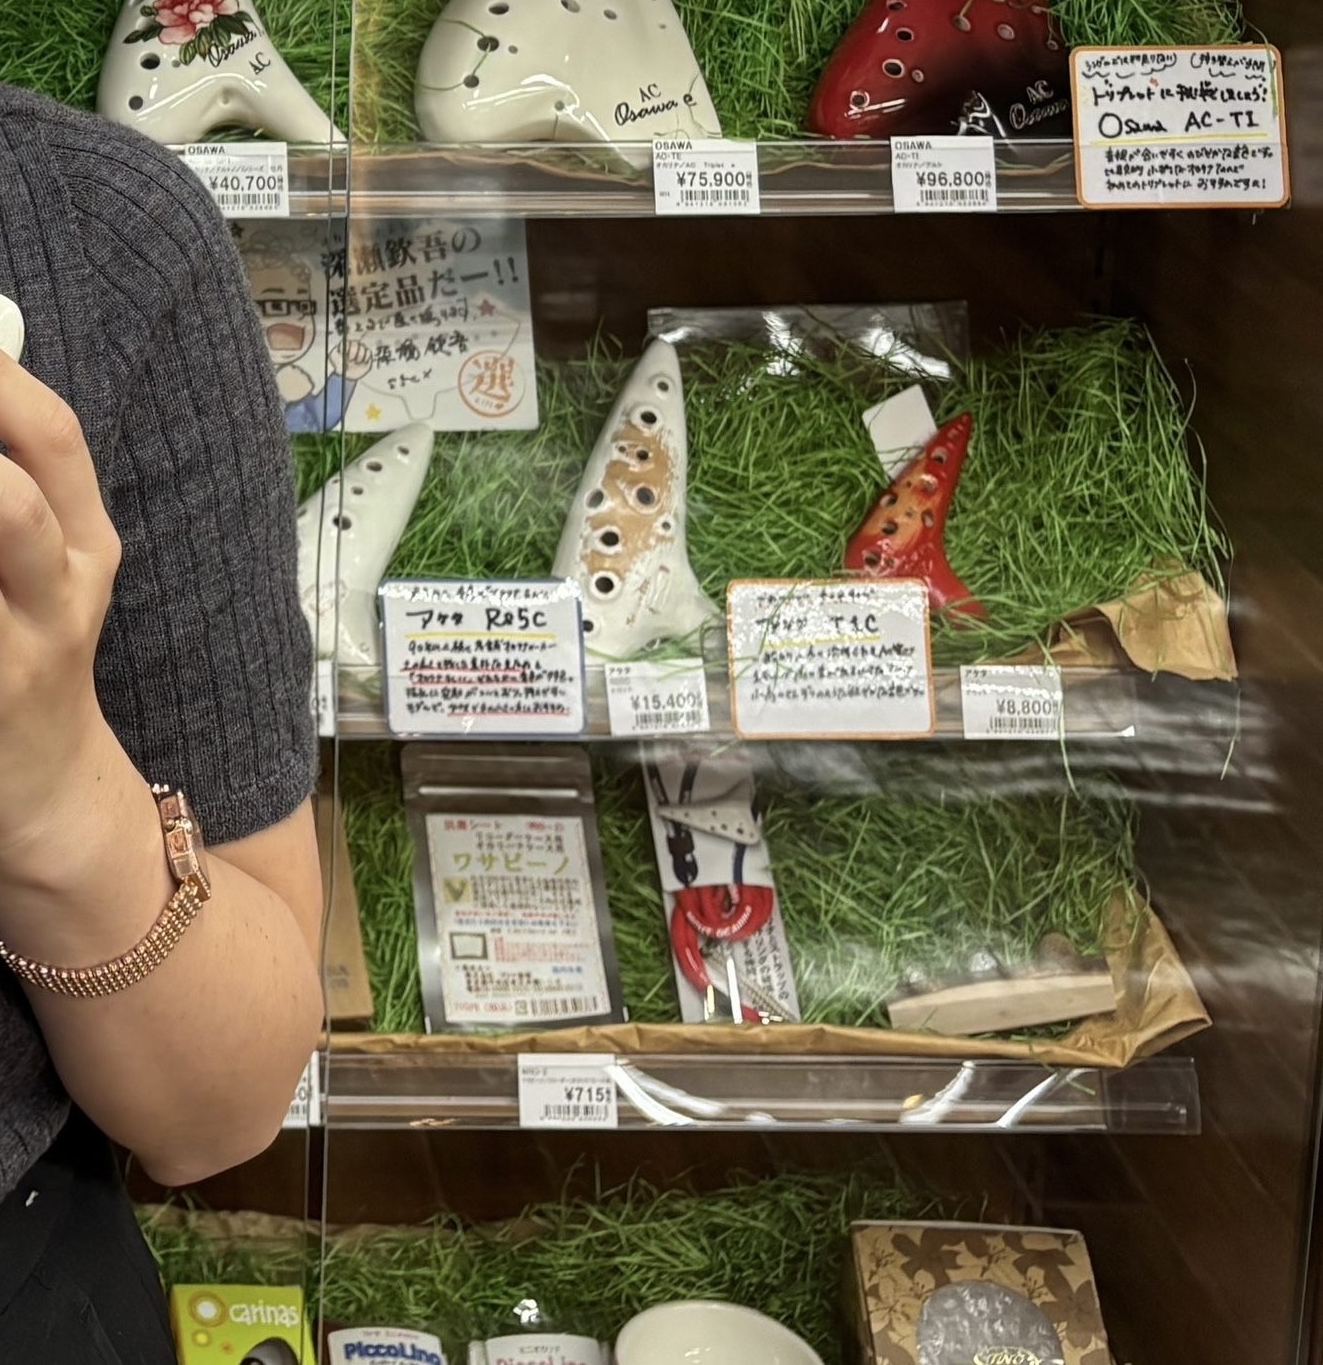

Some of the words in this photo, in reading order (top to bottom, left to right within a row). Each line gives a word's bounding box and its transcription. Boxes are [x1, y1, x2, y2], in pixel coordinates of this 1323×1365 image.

[247, 51, 272, 76] AC
[639, 83, 662, 102] AC
[1026, 80, 1055, 104] AC
[614, 97, 679, 127] Osawa
[1184, 111, 1259, 133] AC-TI
[187, 145, 226, 155] OSAWA
[654, 141, 693, 151] OSAWA
[894, 141, 933, 151] OSAWA
[209, 175, 277, 192] ¥40,700
[676, 172, 746, 187] ¥75,900
[916, 172, 985, 187] ¥96,800
[630, 694, 696, 711] ¥15,400
[995, 698, 1053, 716] ¥8,800
[452, 852, 570, 875] ワサビーノ
[564, 1087, 605, 1102] ¥715
